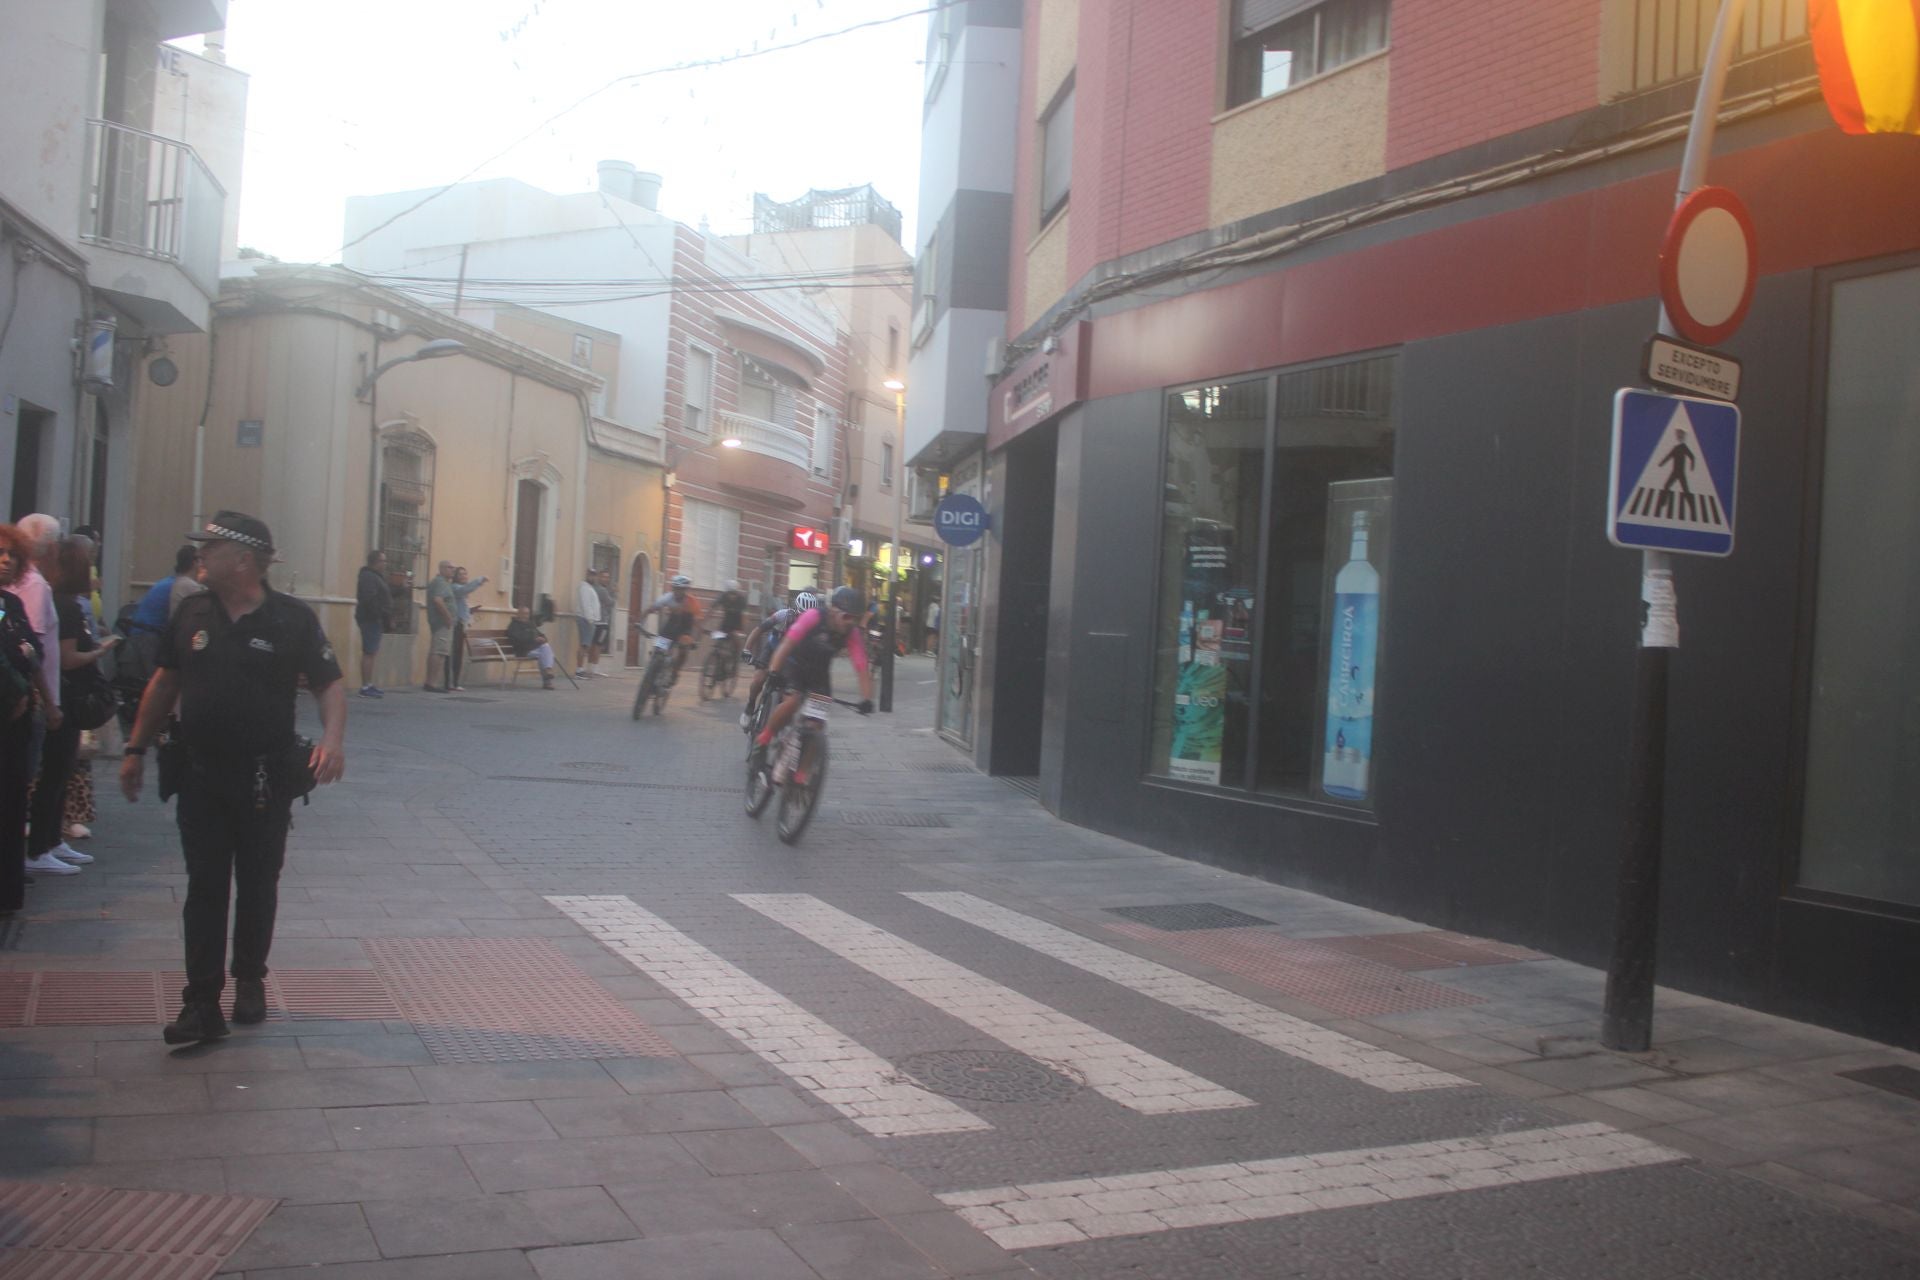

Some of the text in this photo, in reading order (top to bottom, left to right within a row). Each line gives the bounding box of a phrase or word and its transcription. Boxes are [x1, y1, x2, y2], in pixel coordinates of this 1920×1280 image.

[1672, 350, 1721, 374] EXCEPTO
[1657, 363, 1731, 395] SERVIDUMBRE
[941, 511, 980, 526] DIGI
